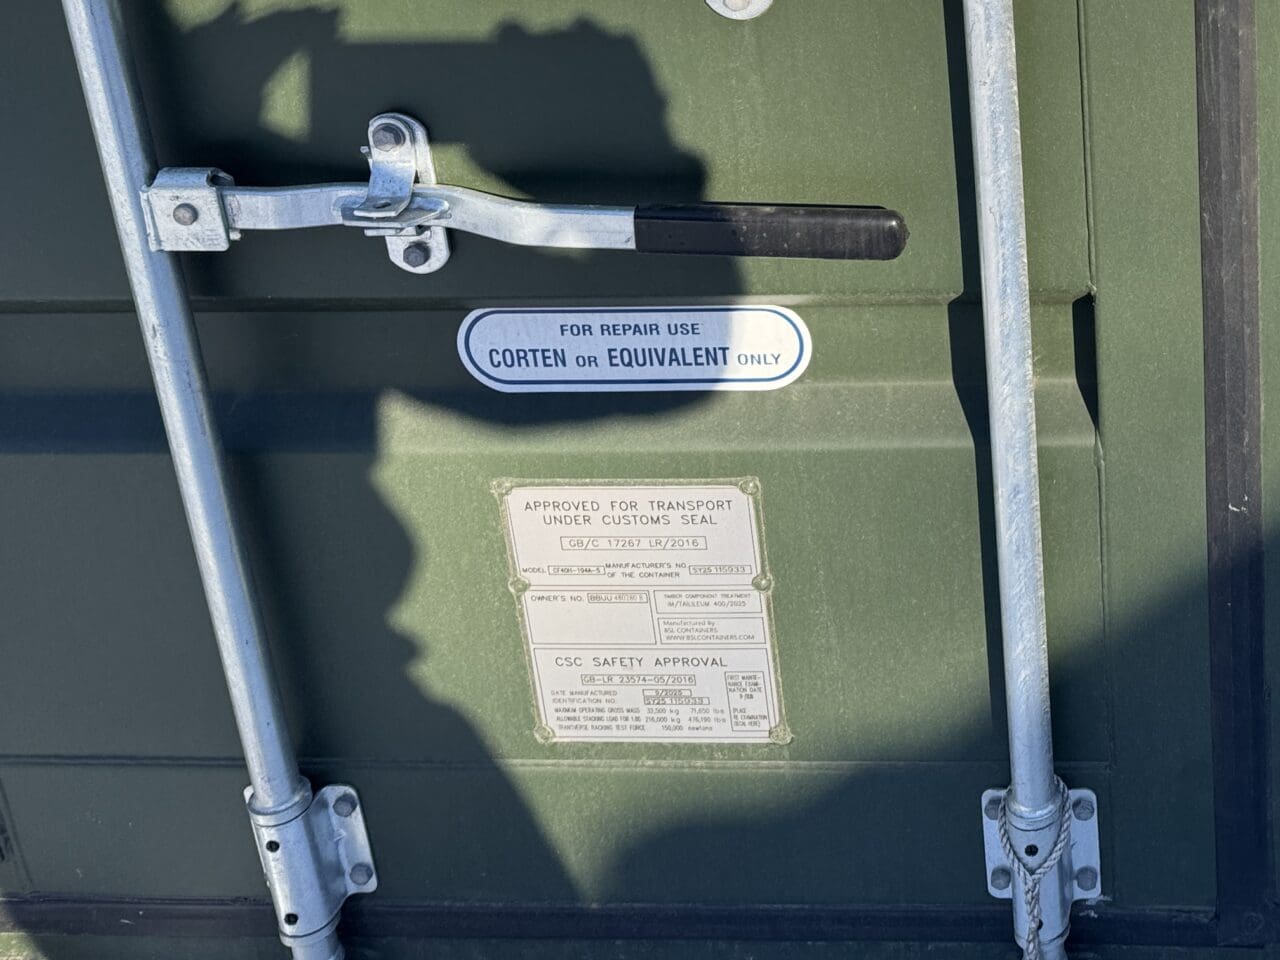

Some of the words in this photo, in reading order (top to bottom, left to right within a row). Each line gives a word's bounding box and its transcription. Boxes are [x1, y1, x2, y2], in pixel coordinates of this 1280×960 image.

[559, 323, 593, 337] FOR
[600, 323, 660, 337] REPAIR
[667, 323, 701, 336] USE
[488, 347, 567, 369] CORTEN
[576, 354, 598, 368] OR
[607, 346, 730, 368] EQUIVALENT
[737, 352, 782, 366] ONLY
[524, 500, 600, 512] APPROVED
[610, 500, 639, 512] FOR
[648, 500, 733, 511] TRANSPORT
[543, 514, 592, 526] UNDER
[602, 514, 671, 525] CUSTOMS
[681, 514, 718, 525] SEAL
[568, 538, 600, 549] GB/C
[607, 538, 642, 548] 17267
[649, 538, 700, 549] LR/2016
[555, 656, 583, 667] CSC
[593, 657, 644, 667] SAFETY
[654, 657, 728, 667] APPROVAL
[583, 675, 614, 684] GB-LR
